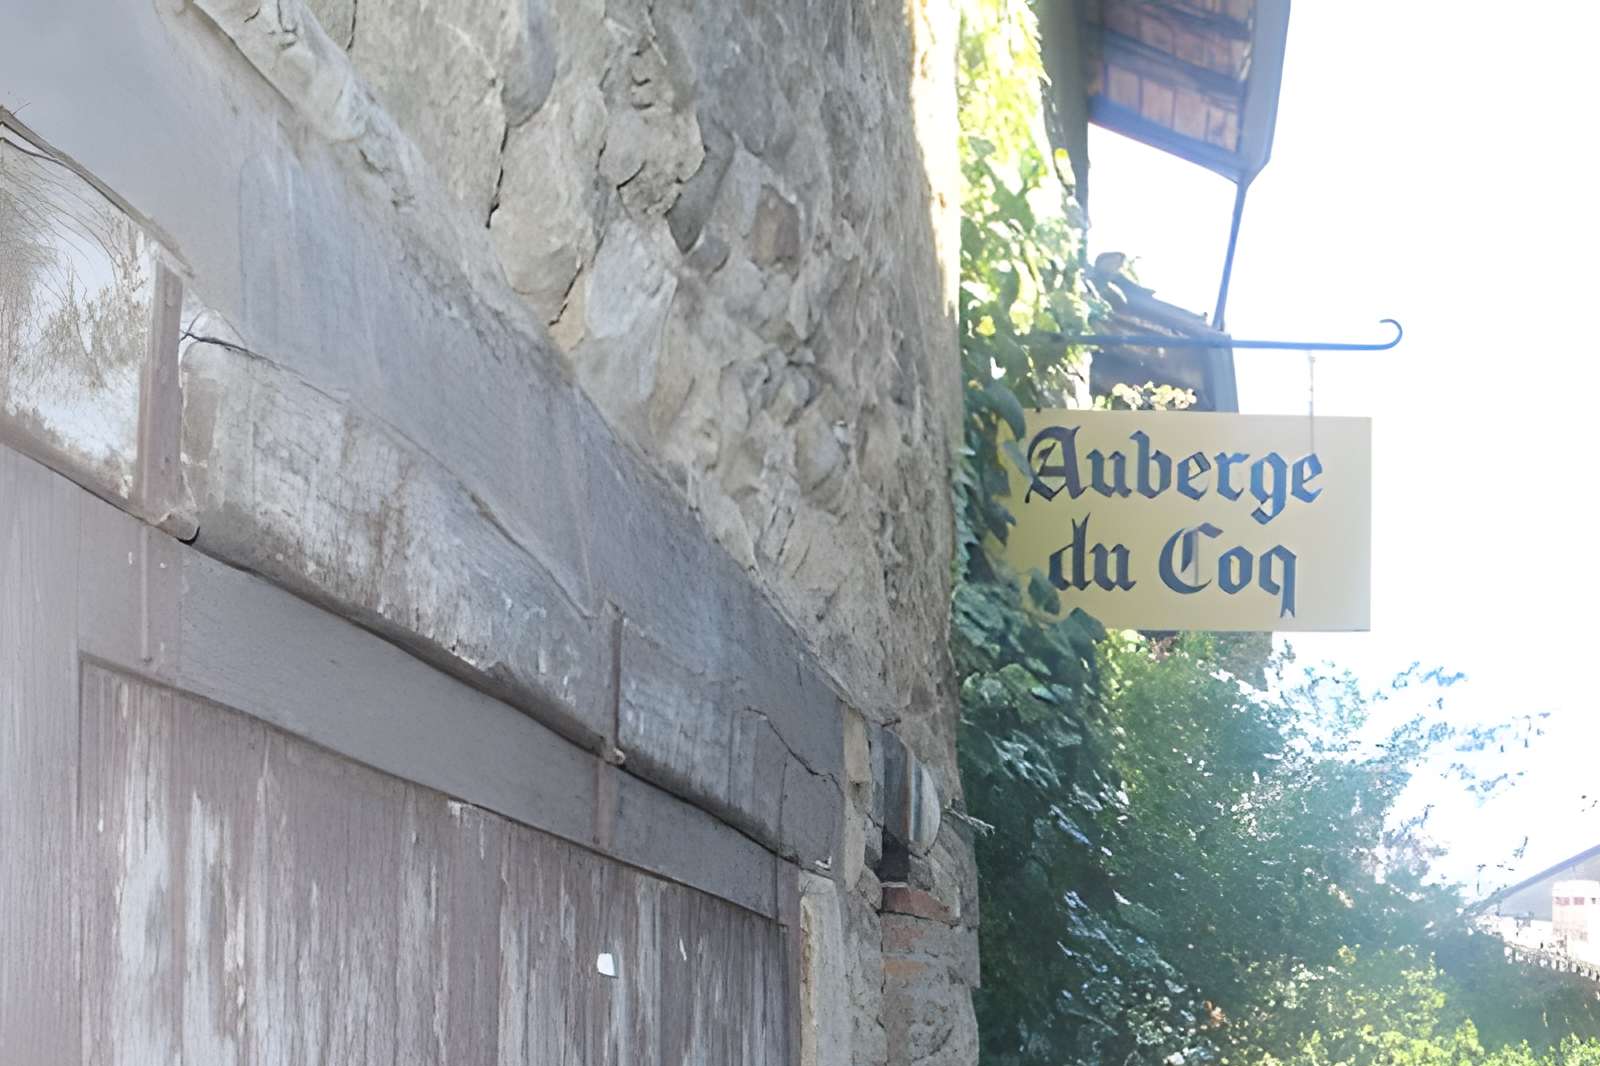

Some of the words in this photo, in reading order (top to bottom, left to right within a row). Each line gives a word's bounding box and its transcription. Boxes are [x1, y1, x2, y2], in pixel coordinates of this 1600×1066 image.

[1024, 425, 1325, 526] Auberge
[1047, 511, 1137, 593] du
[1157, 521, 1298, 619] Coq
